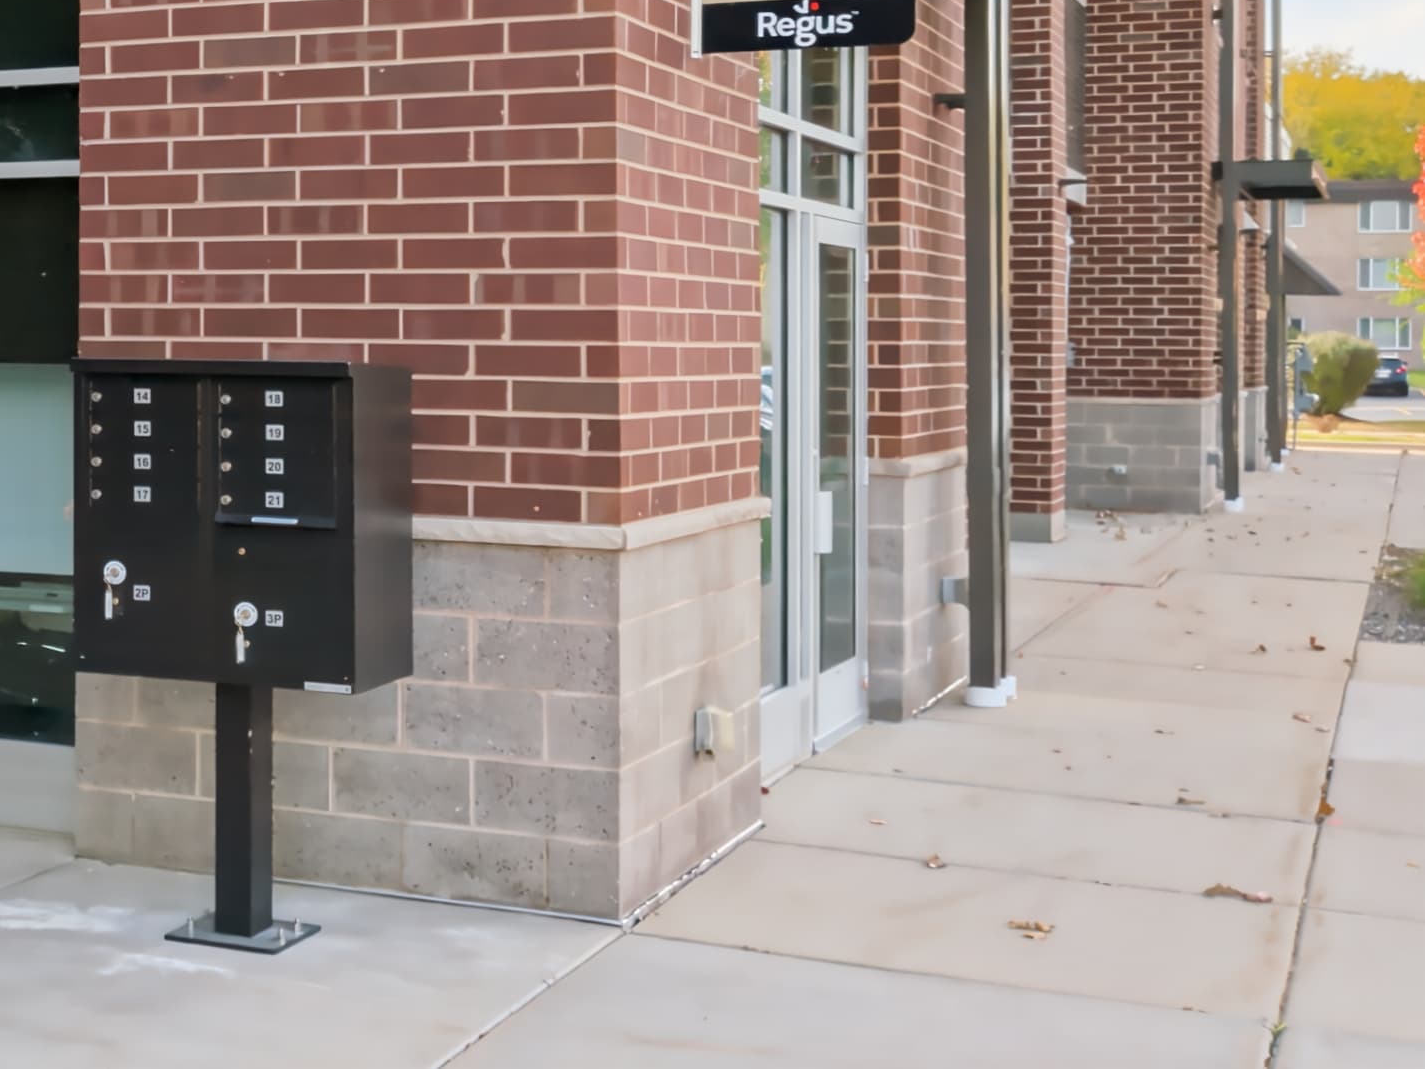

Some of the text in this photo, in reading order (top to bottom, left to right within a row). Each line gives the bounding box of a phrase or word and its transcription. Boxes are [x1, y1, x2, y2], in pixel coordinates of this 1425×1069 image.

[757, 11, 854, 47] Regus
[136, 391, 149, 401] 14
[268, 394, 281, 404] 18
[136, 424, 149, 434] 15
[268, 428, 281, 439] 19
[136, 457, 149, 468] 16
[267, 461, 281, 472] 20
[136, 490, 149, 500] 17
[267, 494, 281, 505] 21
[135, 587, 149, 598] 2P
[267, 613, 281, 624] 3P
